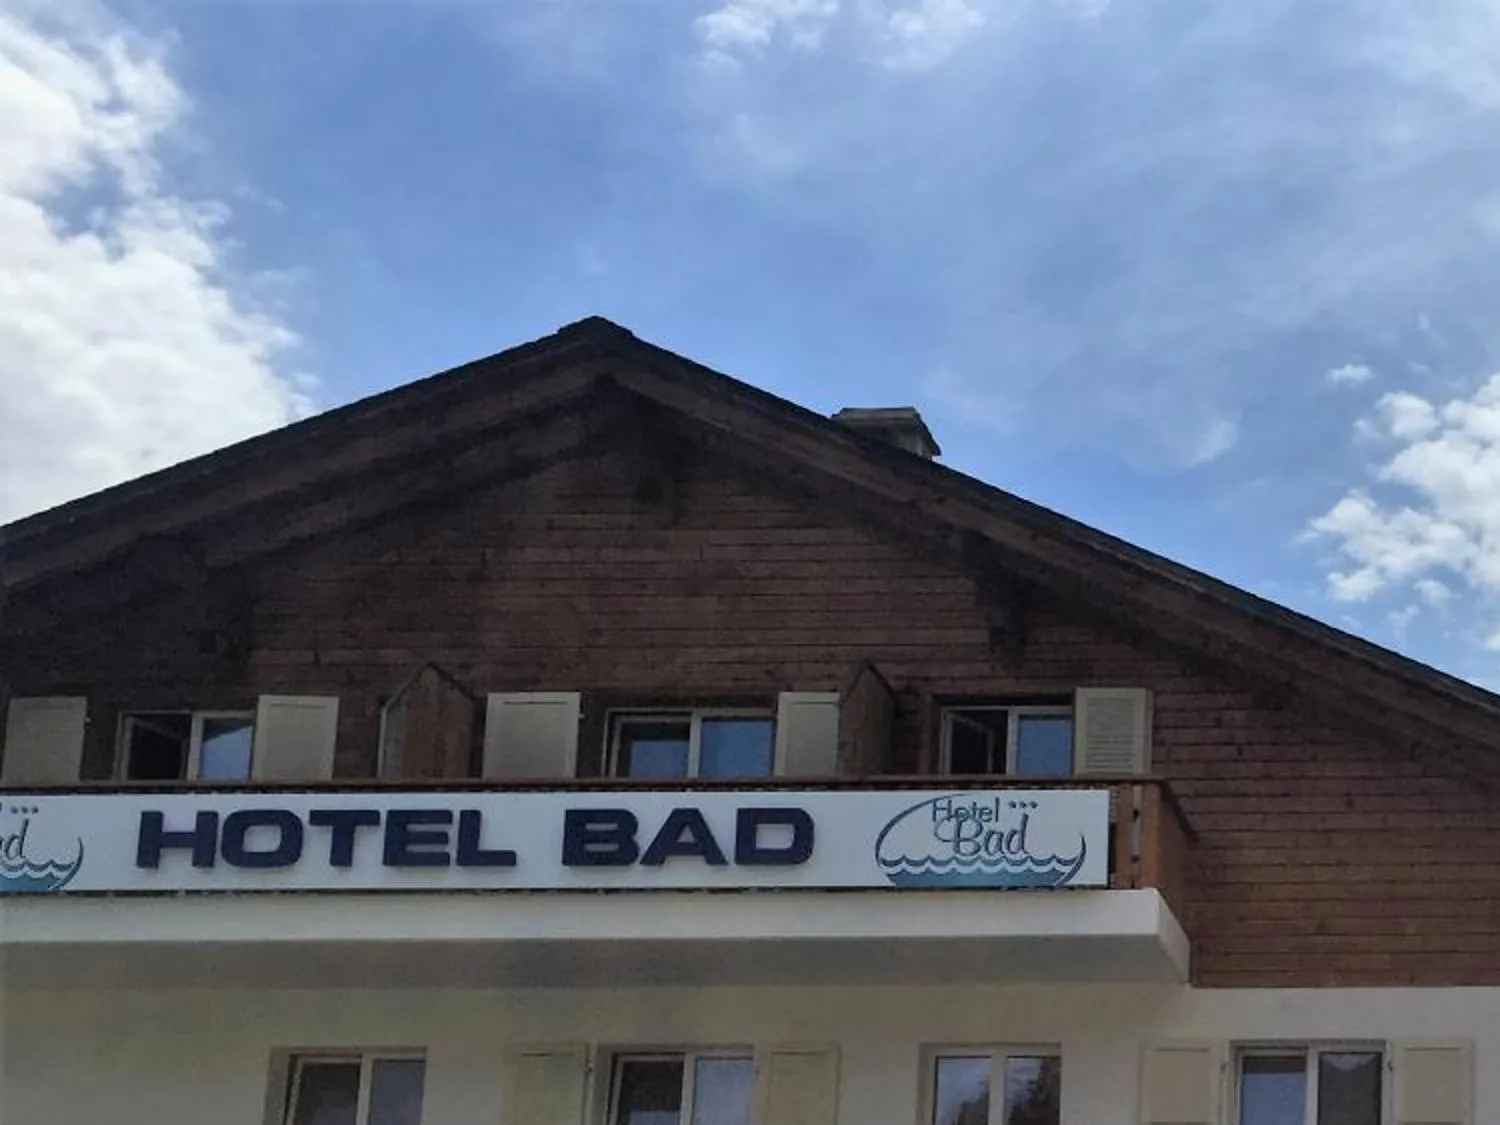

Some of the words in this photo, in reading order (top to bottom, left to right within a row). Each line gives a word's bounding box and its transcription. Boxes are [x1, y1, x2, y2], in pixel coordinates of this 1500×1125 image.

[931, 797, 1000, 823] Hotel
[136, 808, 517, 869] HOTEL
[561, 807, 815, 866] BAD
[934, 813, 1029, 857] Bad
